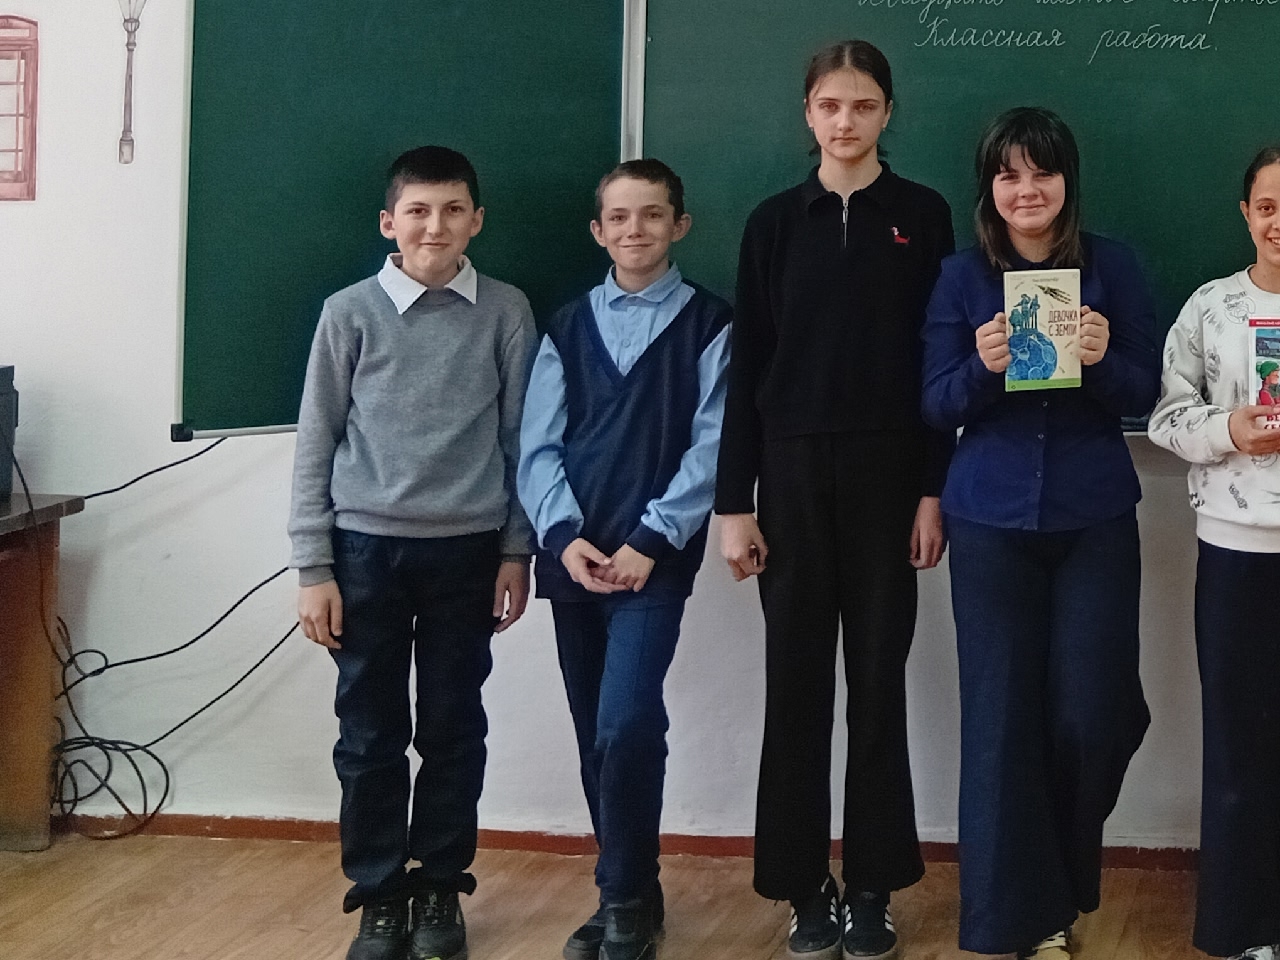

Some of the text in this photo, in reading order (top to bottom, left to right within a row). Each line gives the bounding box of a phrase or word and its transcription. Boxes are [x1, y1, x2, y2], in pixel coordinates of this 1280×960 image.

[914, 16, 1065, 47] Классная
[1048, 310, 1078, 323] ДЕВОЧКА
[1048, 323, 1077, 336] С ЗЕМЛИ
